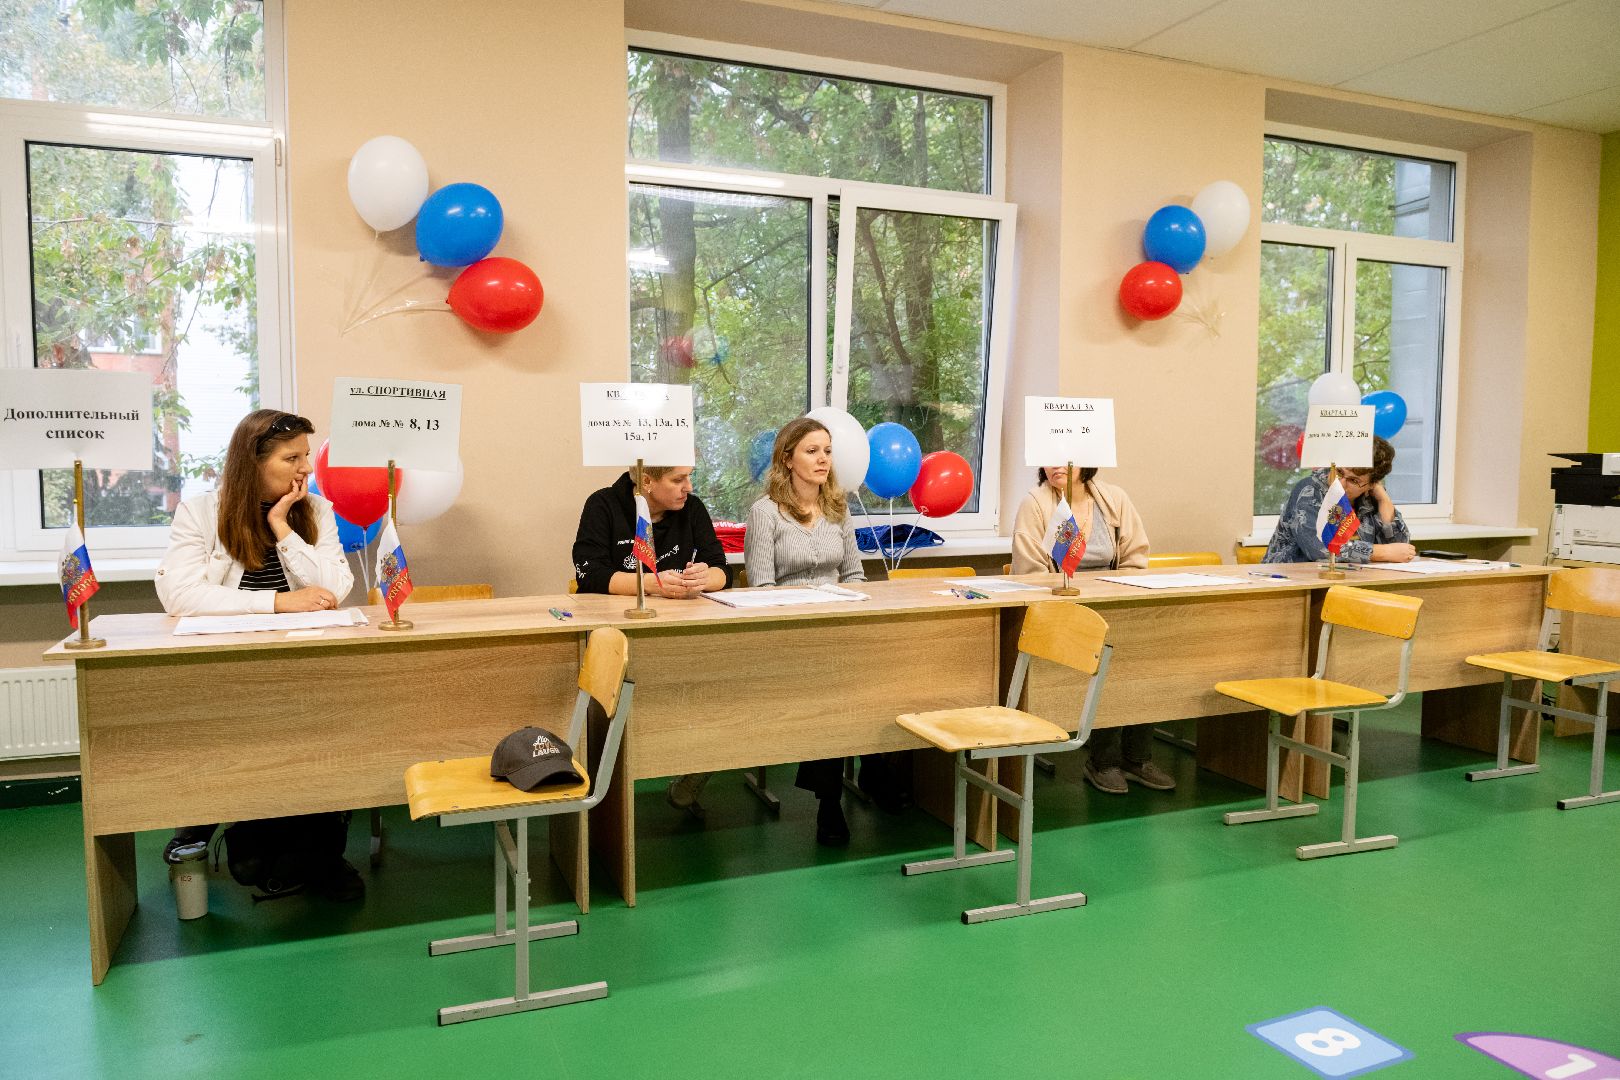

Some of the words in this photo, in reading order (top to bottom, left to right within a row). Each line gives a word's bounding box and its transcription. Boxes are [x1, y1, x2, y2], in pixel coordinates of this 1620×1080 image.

[367, 385, 446, 399] СПОРТИВНАЯ
[4, 408, 140, 421] Дополнительный
[352, 420, 376, 428] дома
[409, 418, 421, 431] 8,
[426, 419, 440, 431] 13
[676, 418, 689, 428] 15,
[46, 429, 105, 439] список
[1081, 426, 1090, 434] 26
[624, 432, 645, 442] 15а,
[647, 432, 658, 441] 17
[1294, 1027, 1361, 1056] 8
